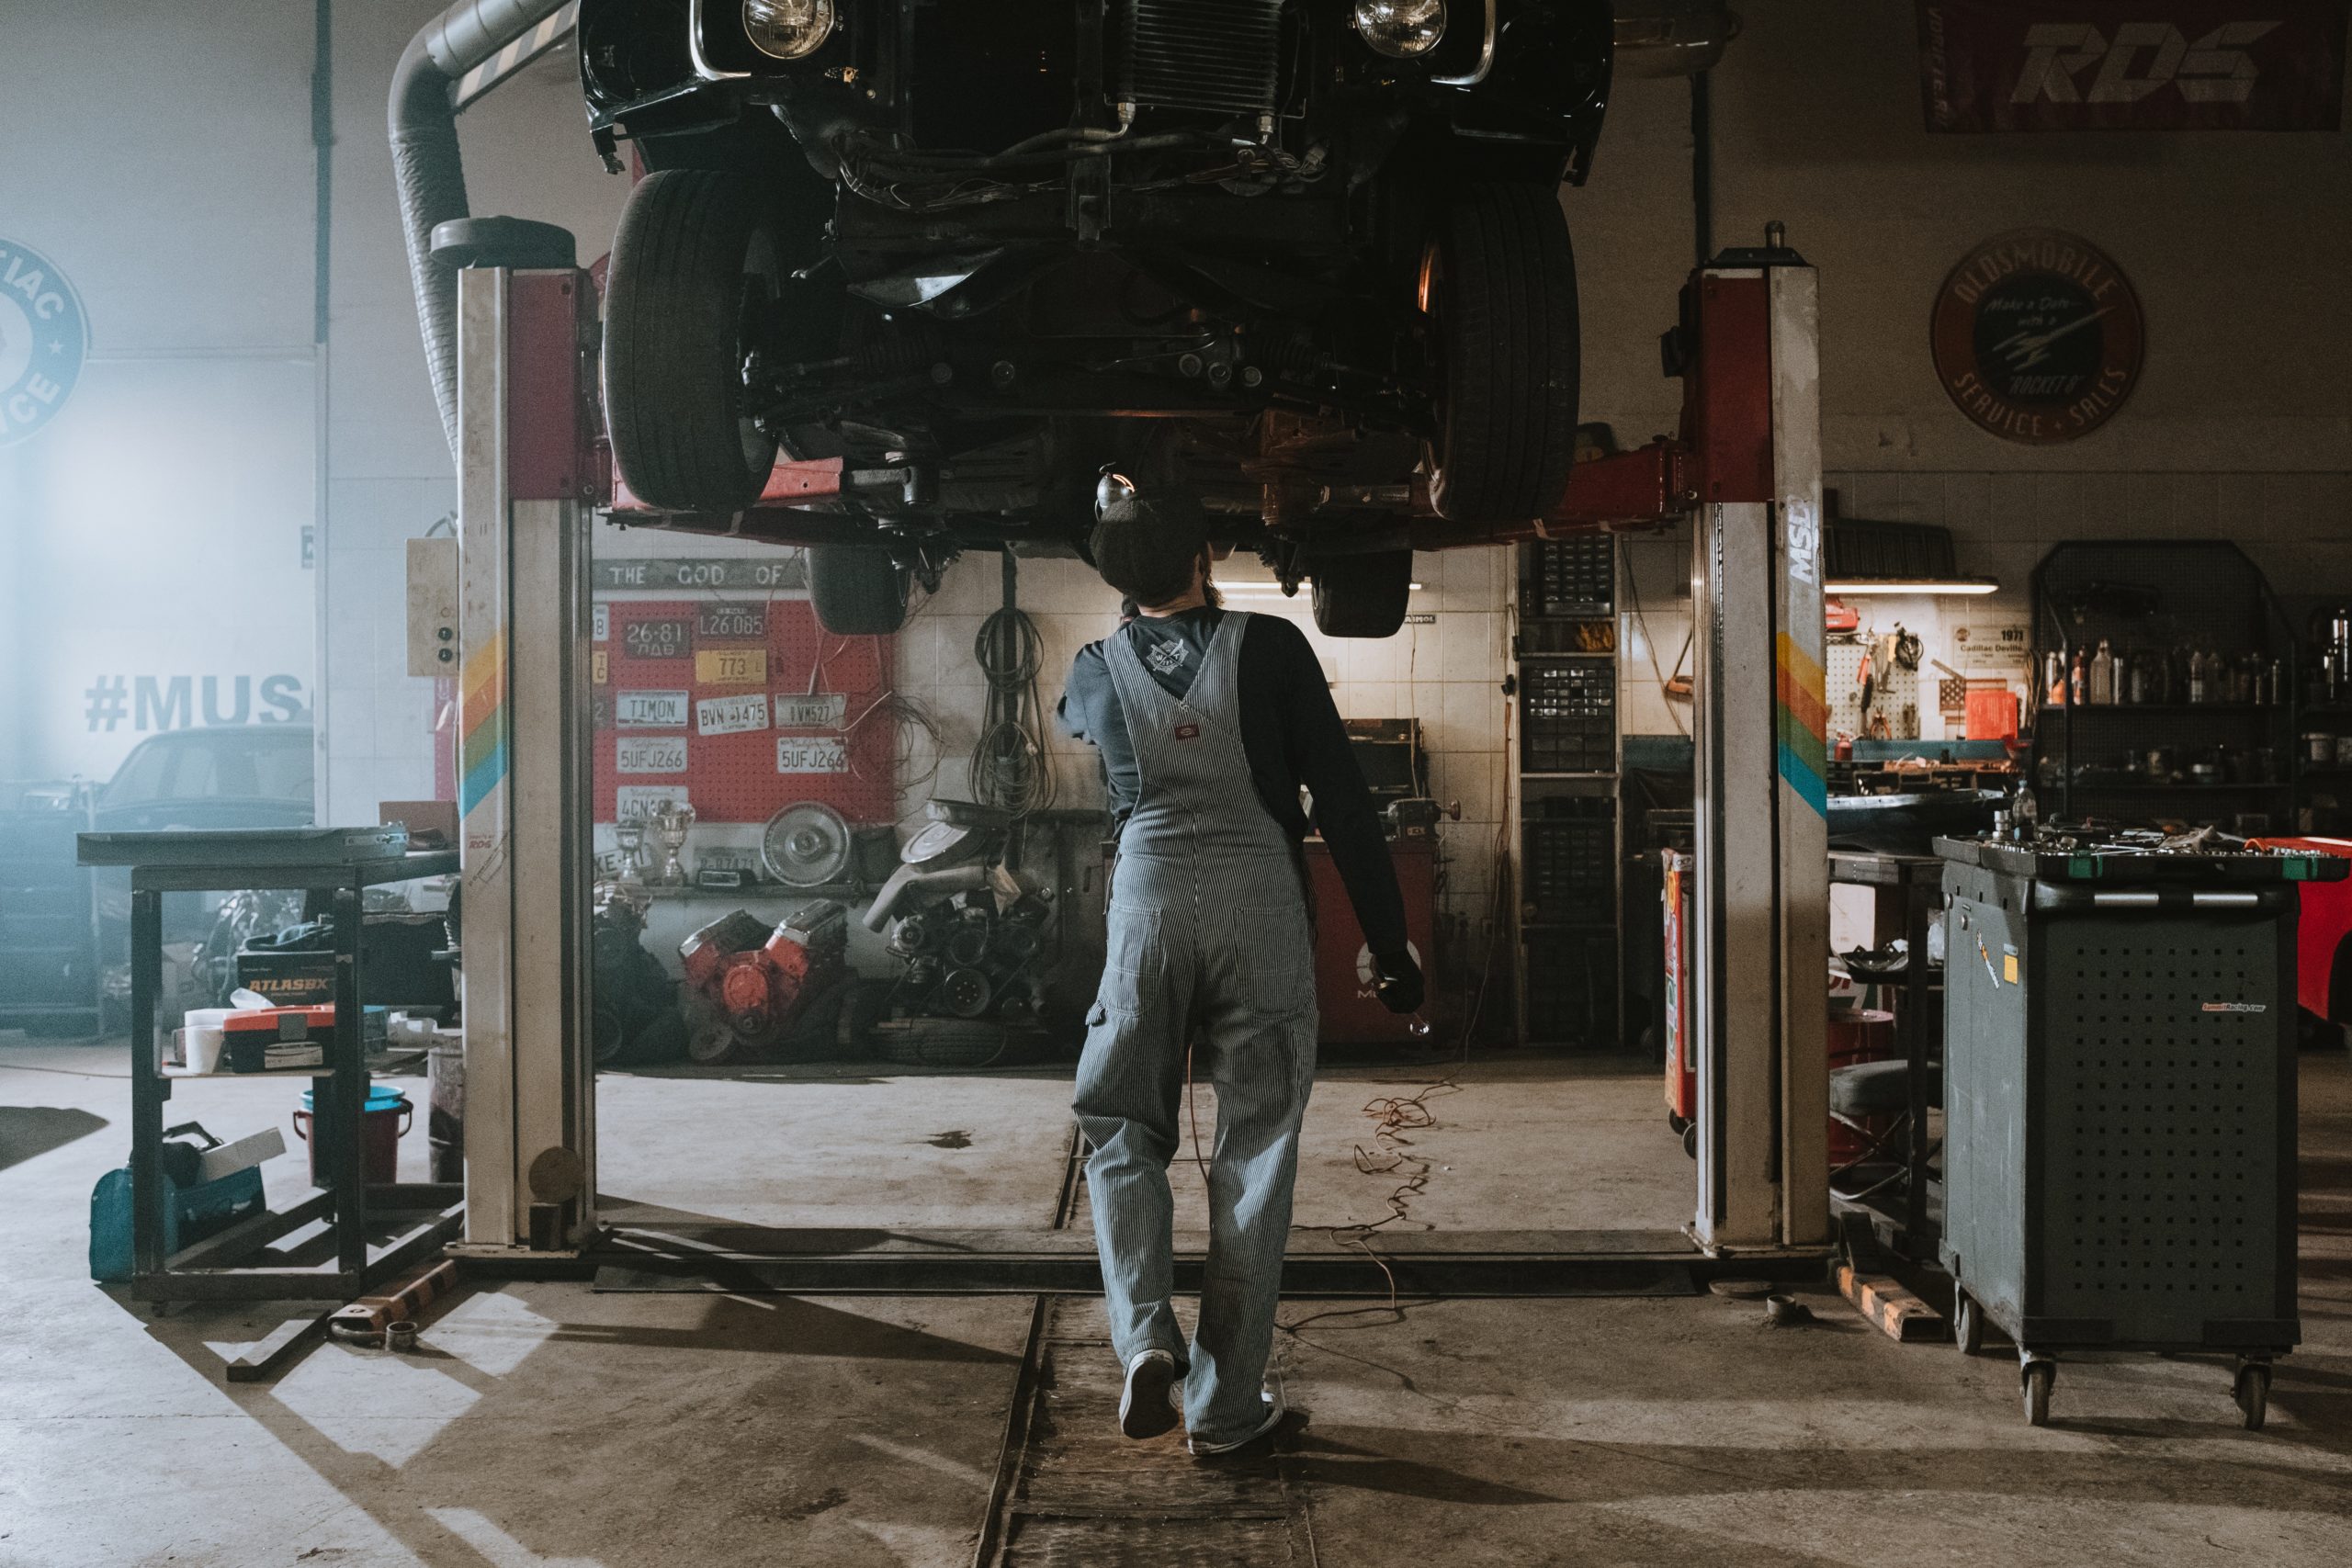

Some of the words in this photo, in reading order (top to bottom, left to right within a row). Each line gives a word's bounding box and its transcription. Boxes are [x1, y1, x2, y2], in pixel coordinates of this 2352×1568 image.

[2010, 20, 2285, 104] RDS
[0, 250, 64, 321] IAC
[1954, 241, 2118, 305] OLDSMOBILE
[1954, 372, 2043, 436] SERVICE
[2069, 367, 2127, 427] SALES
[609, 566, 647, 585] THE
[677, 565, 725, 586] GOD
[755, 565, 786, 585] OF
[2001, 629, 2024, 641] 1971
[719, 658, 747, 675] 773
[629, 699, 676, 719] TIMON
